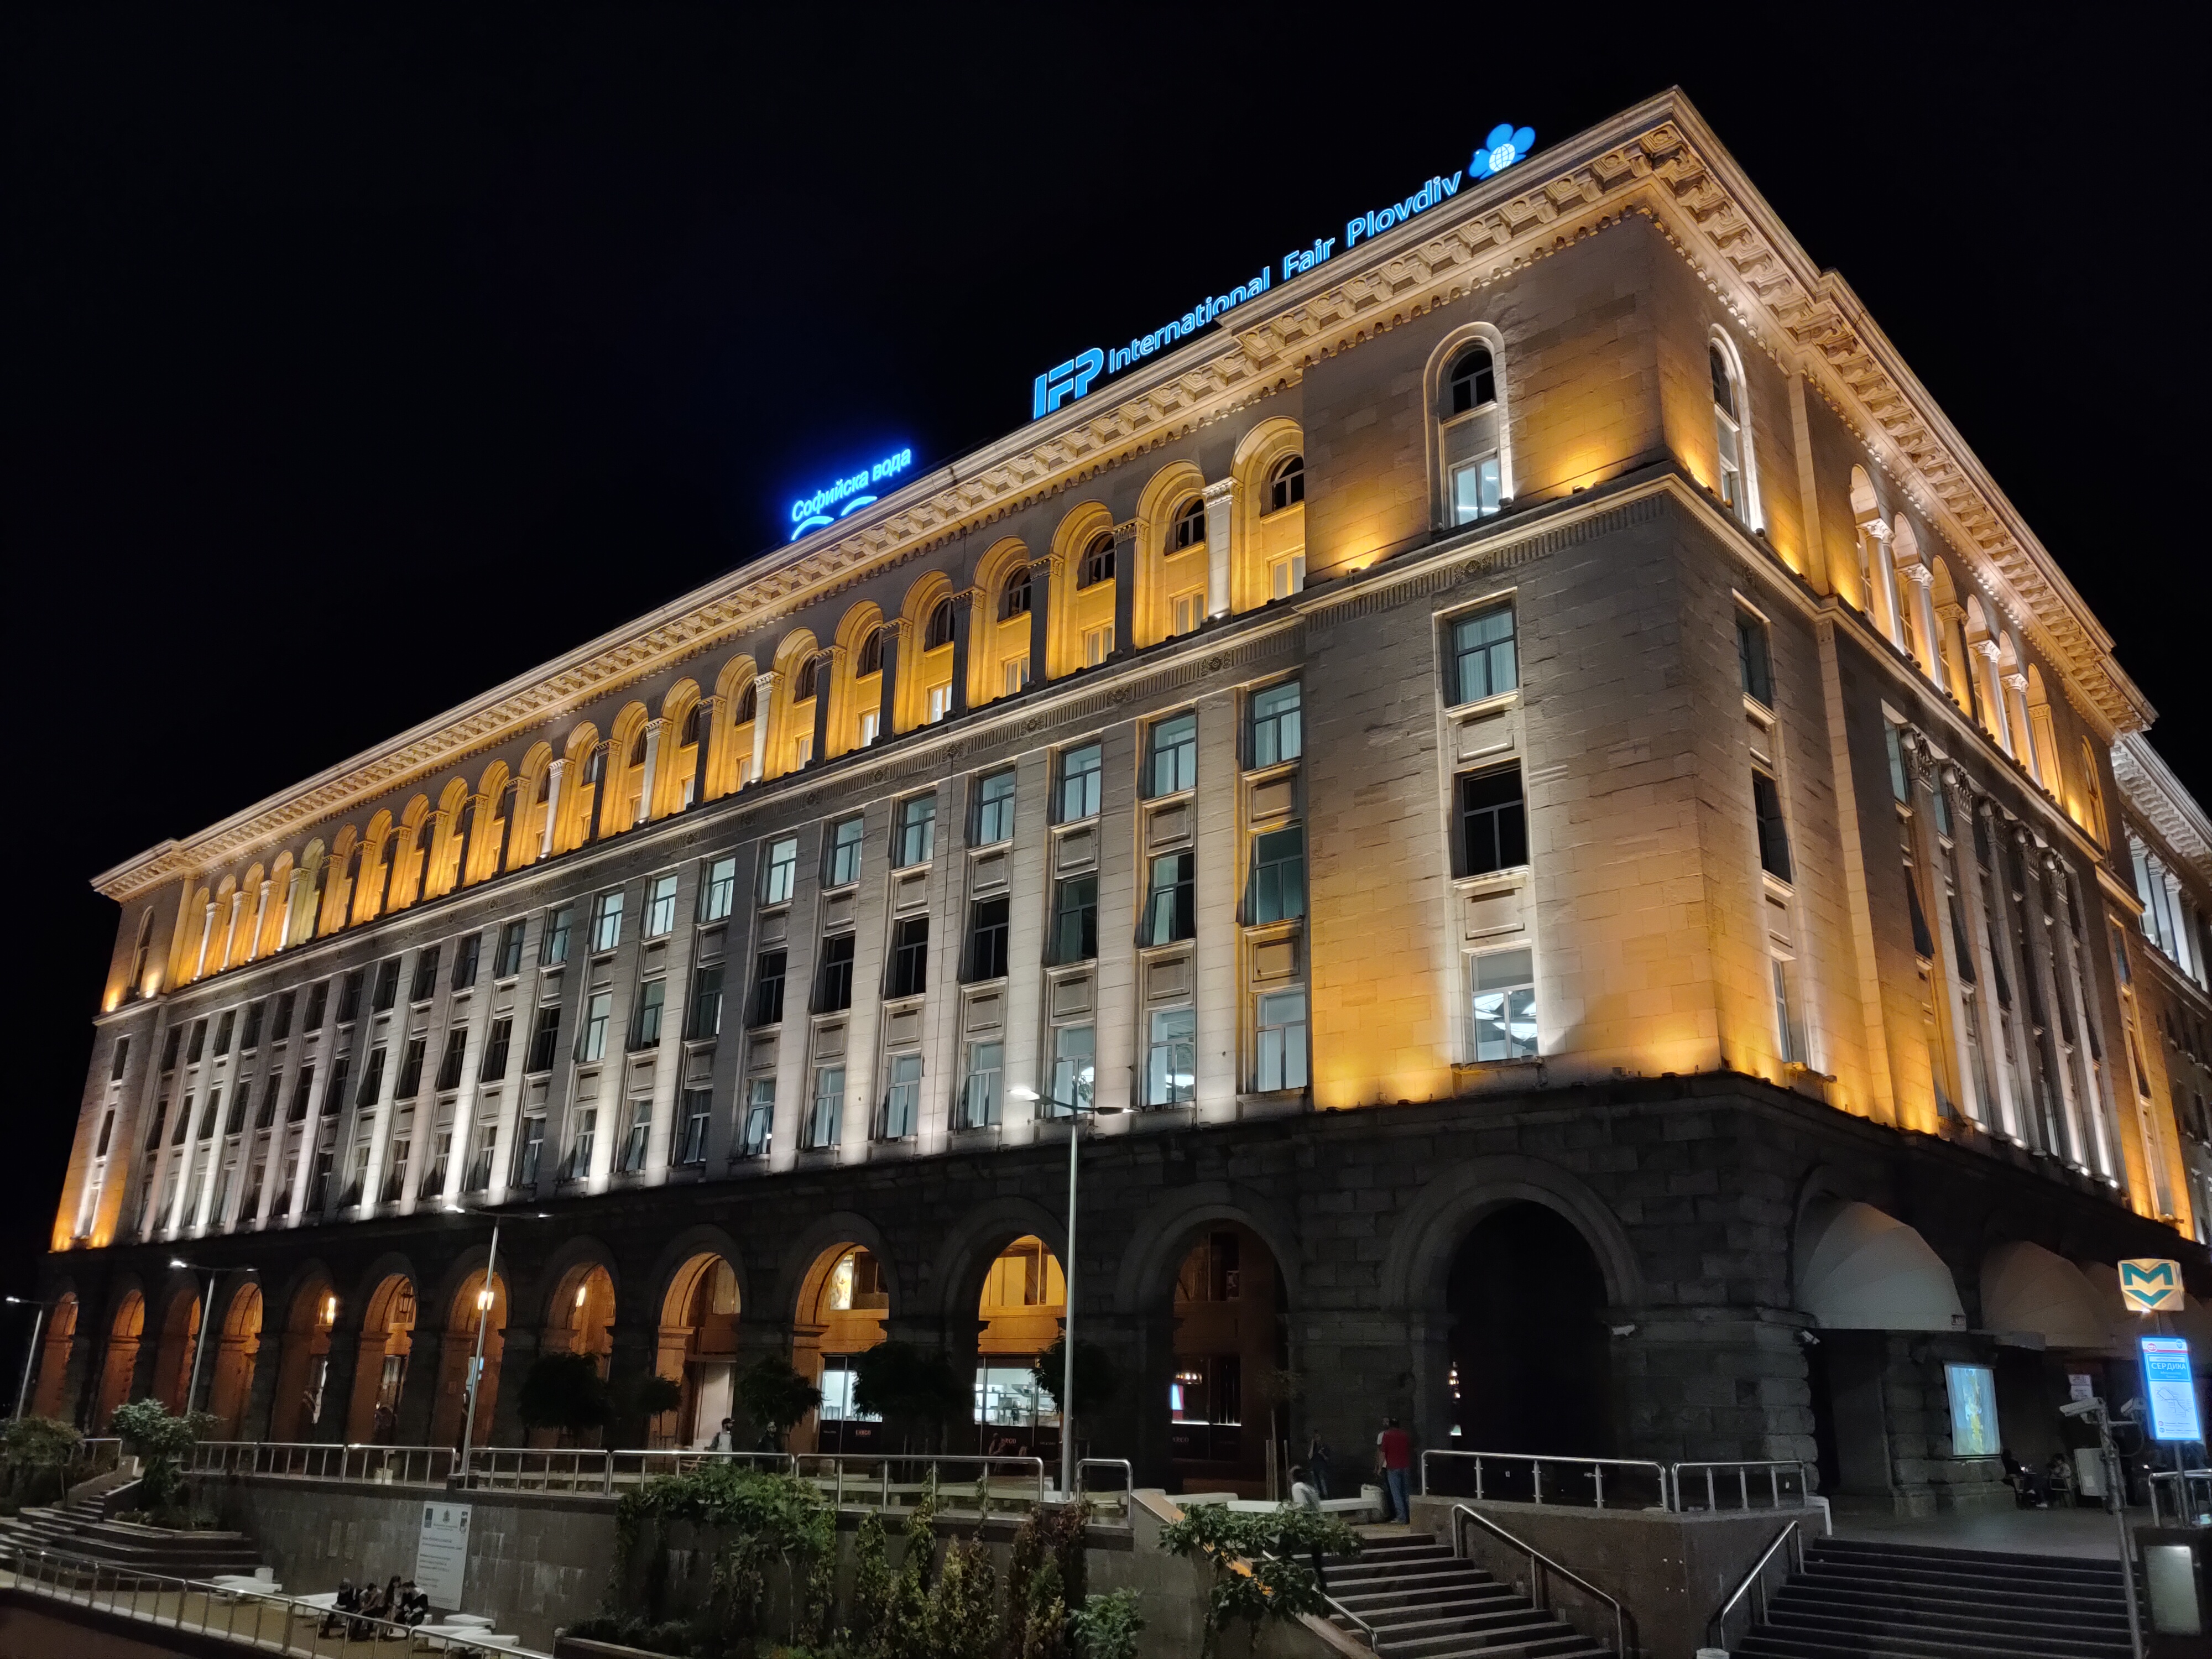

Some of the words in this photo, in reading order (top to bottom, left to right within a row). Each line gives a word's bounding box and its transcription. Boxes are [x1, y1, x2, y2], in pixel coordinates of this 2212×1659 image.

[1033, 347, 1105, 421] IFP
[1108, 265, 1270, 374] International
[1284, 237, 1335, 280] Fair
[1347, 170, 1463, 248] Plovdiv
[791, 470, 869, 522] Софийска
[872, 448, 912, 481] вода
[2151, 1362, 2187, 1371] СЕРДИКА
